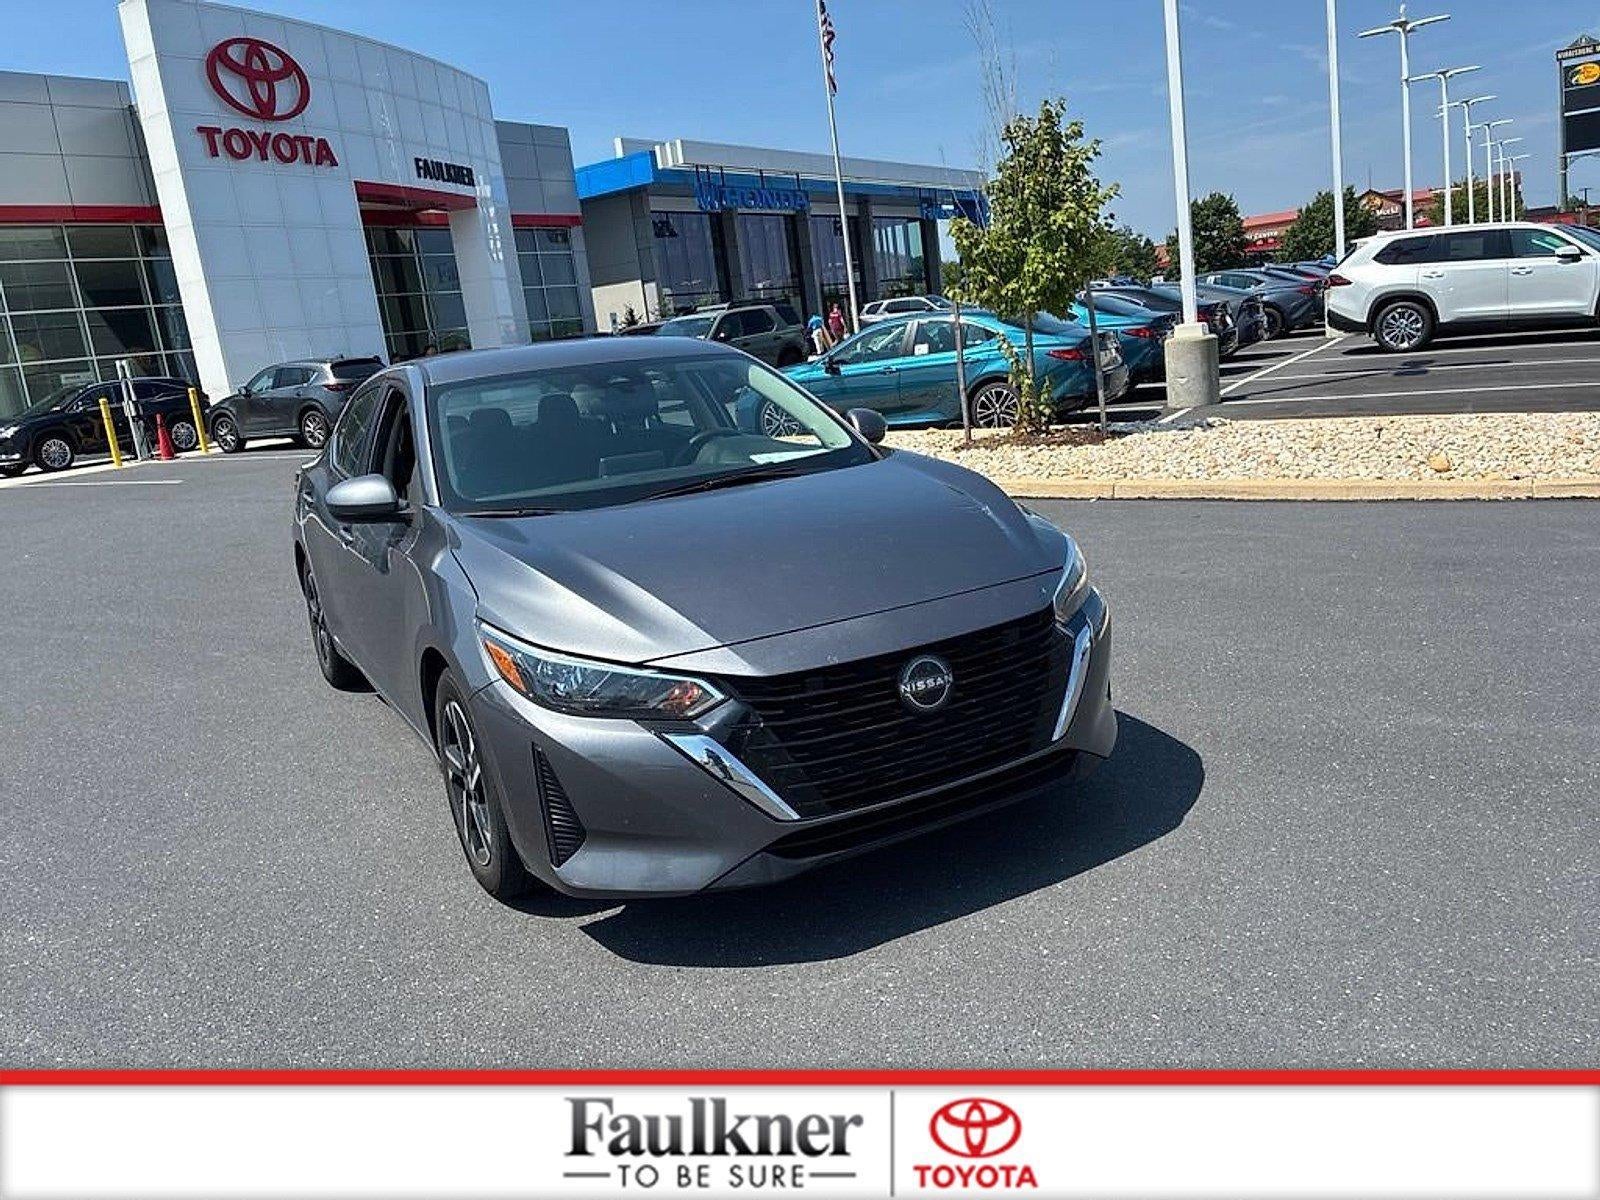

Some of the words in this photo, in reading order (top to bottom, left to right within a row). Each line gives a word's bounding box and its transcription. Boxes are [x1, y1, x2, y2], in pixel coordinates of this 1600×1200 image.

[197, 126, 339, 167] TOYOTA
[414, 157, 475, 187] FAULKNER
[900, 673, 953, 693] NISSAN
